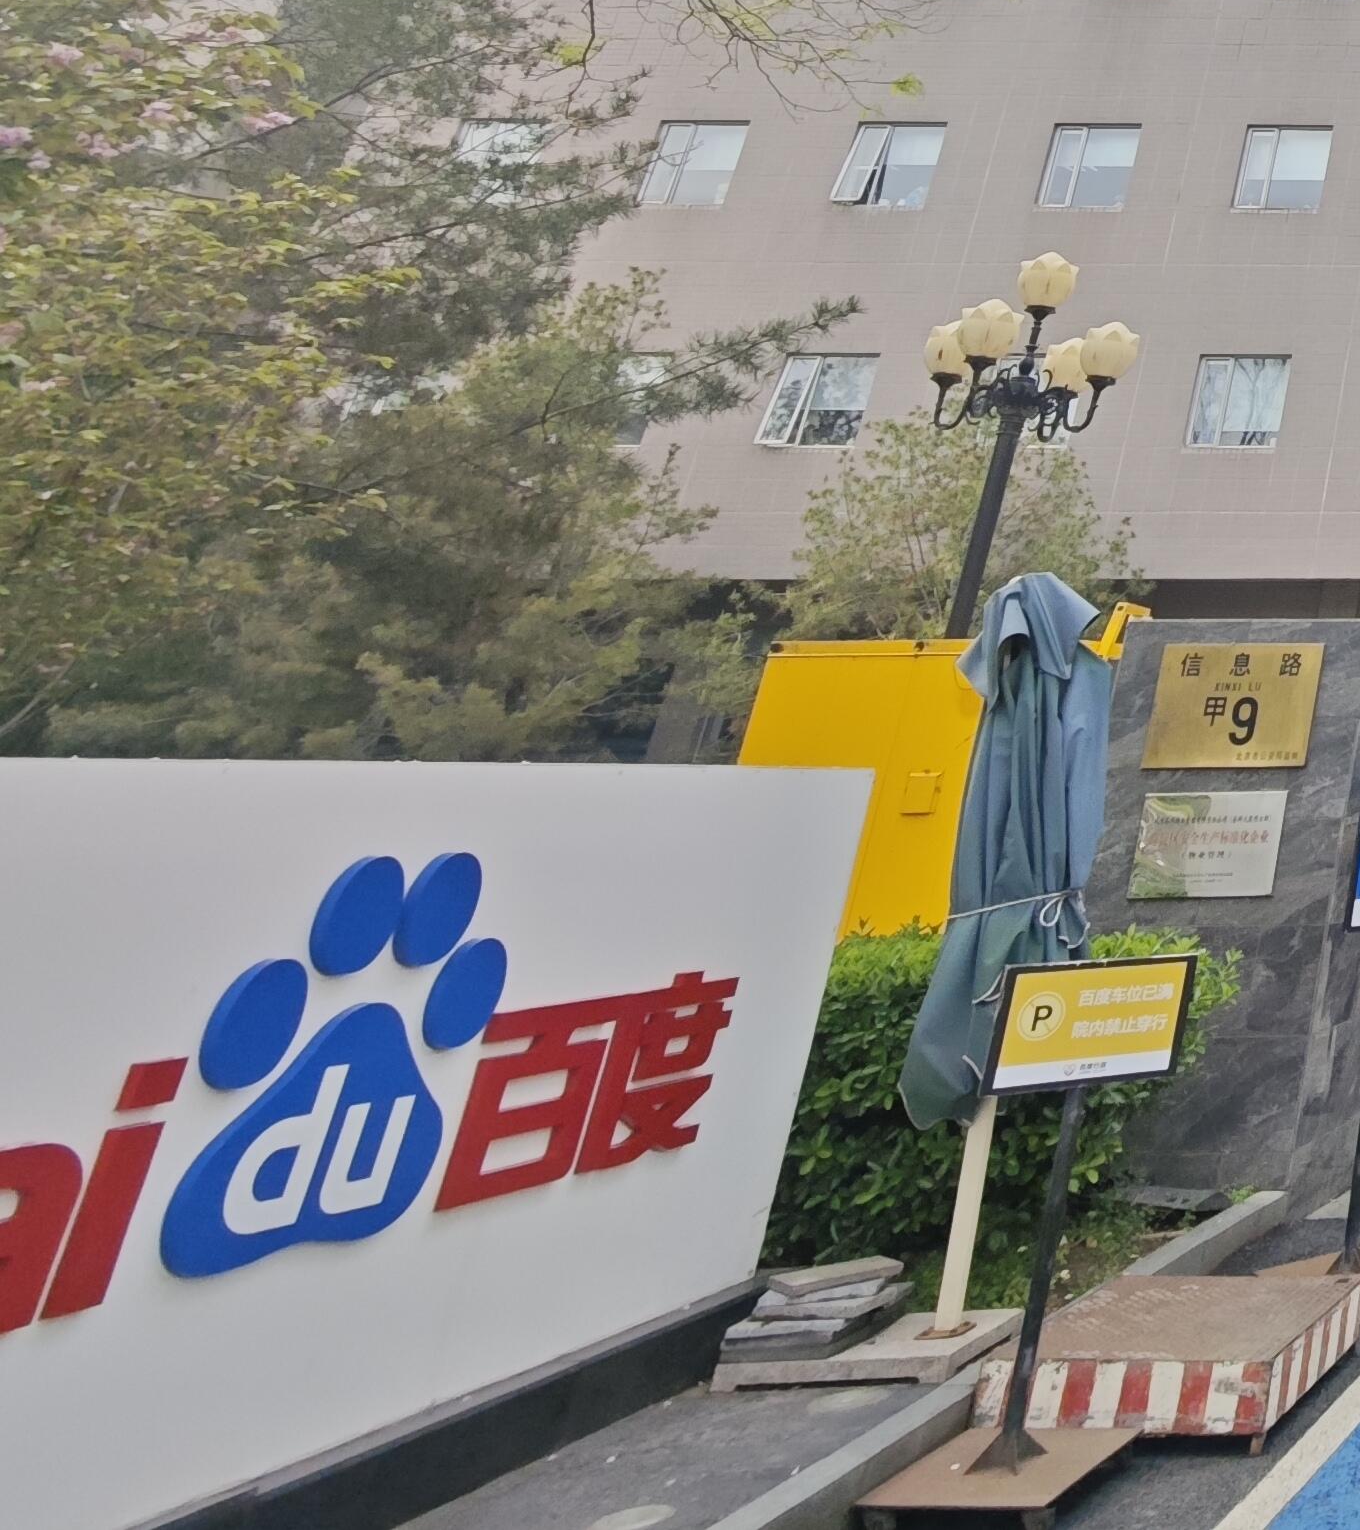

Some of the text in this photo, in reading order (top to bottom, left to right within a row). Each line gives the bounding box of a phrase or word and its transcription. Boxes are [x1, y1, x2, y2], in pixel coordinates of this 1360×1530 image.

[1180, 652, 1302, 677] 信息路
[1214, 682, 1262, 692] XINXI LU
[1078, 983, 1175, 1007] 百度车位已满
[1031, 1005, 1053, 1032] P
[1070, 1013, 1169, 1039] 院内禁止穿行
[433, 970, 740, 1212] 百度
